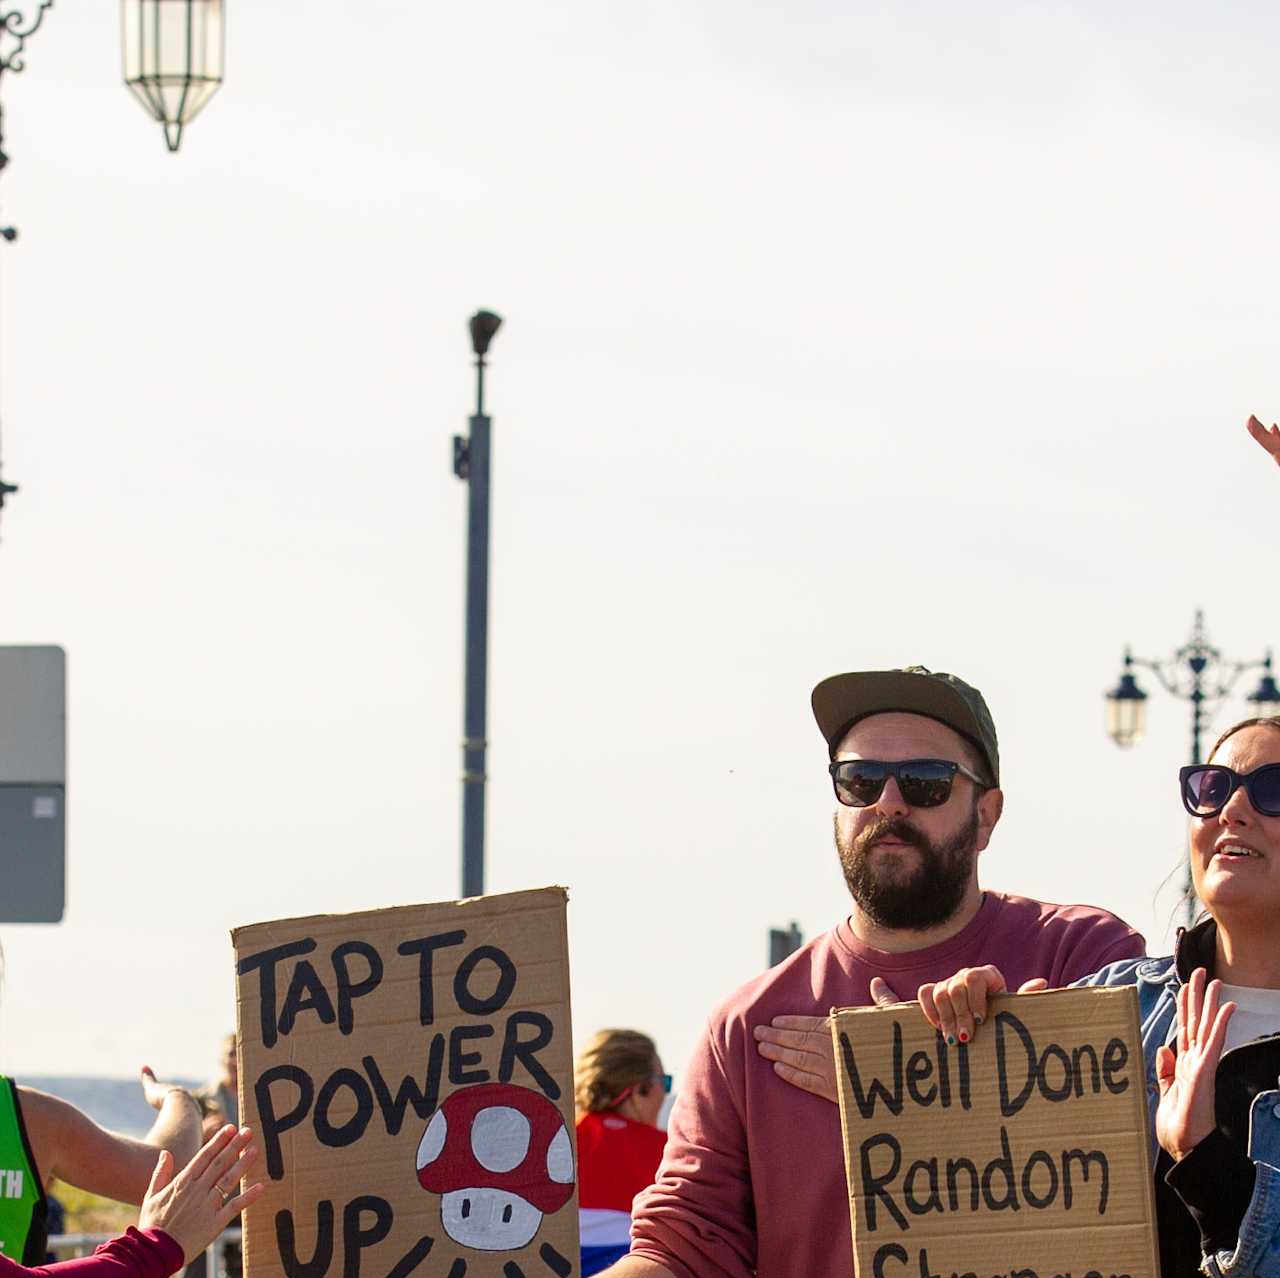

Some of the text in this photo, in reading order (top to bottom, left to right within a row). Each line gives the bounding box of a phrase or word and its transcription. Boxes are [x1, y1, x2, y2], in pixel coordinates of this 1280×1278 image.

[238, 929, 517, 1048] TAP TO
[255, 1010, 562, 1180] POWER
[839, 1010, 1130, 1119] Well Done
[859, 1125, 1110, 1232] Random
